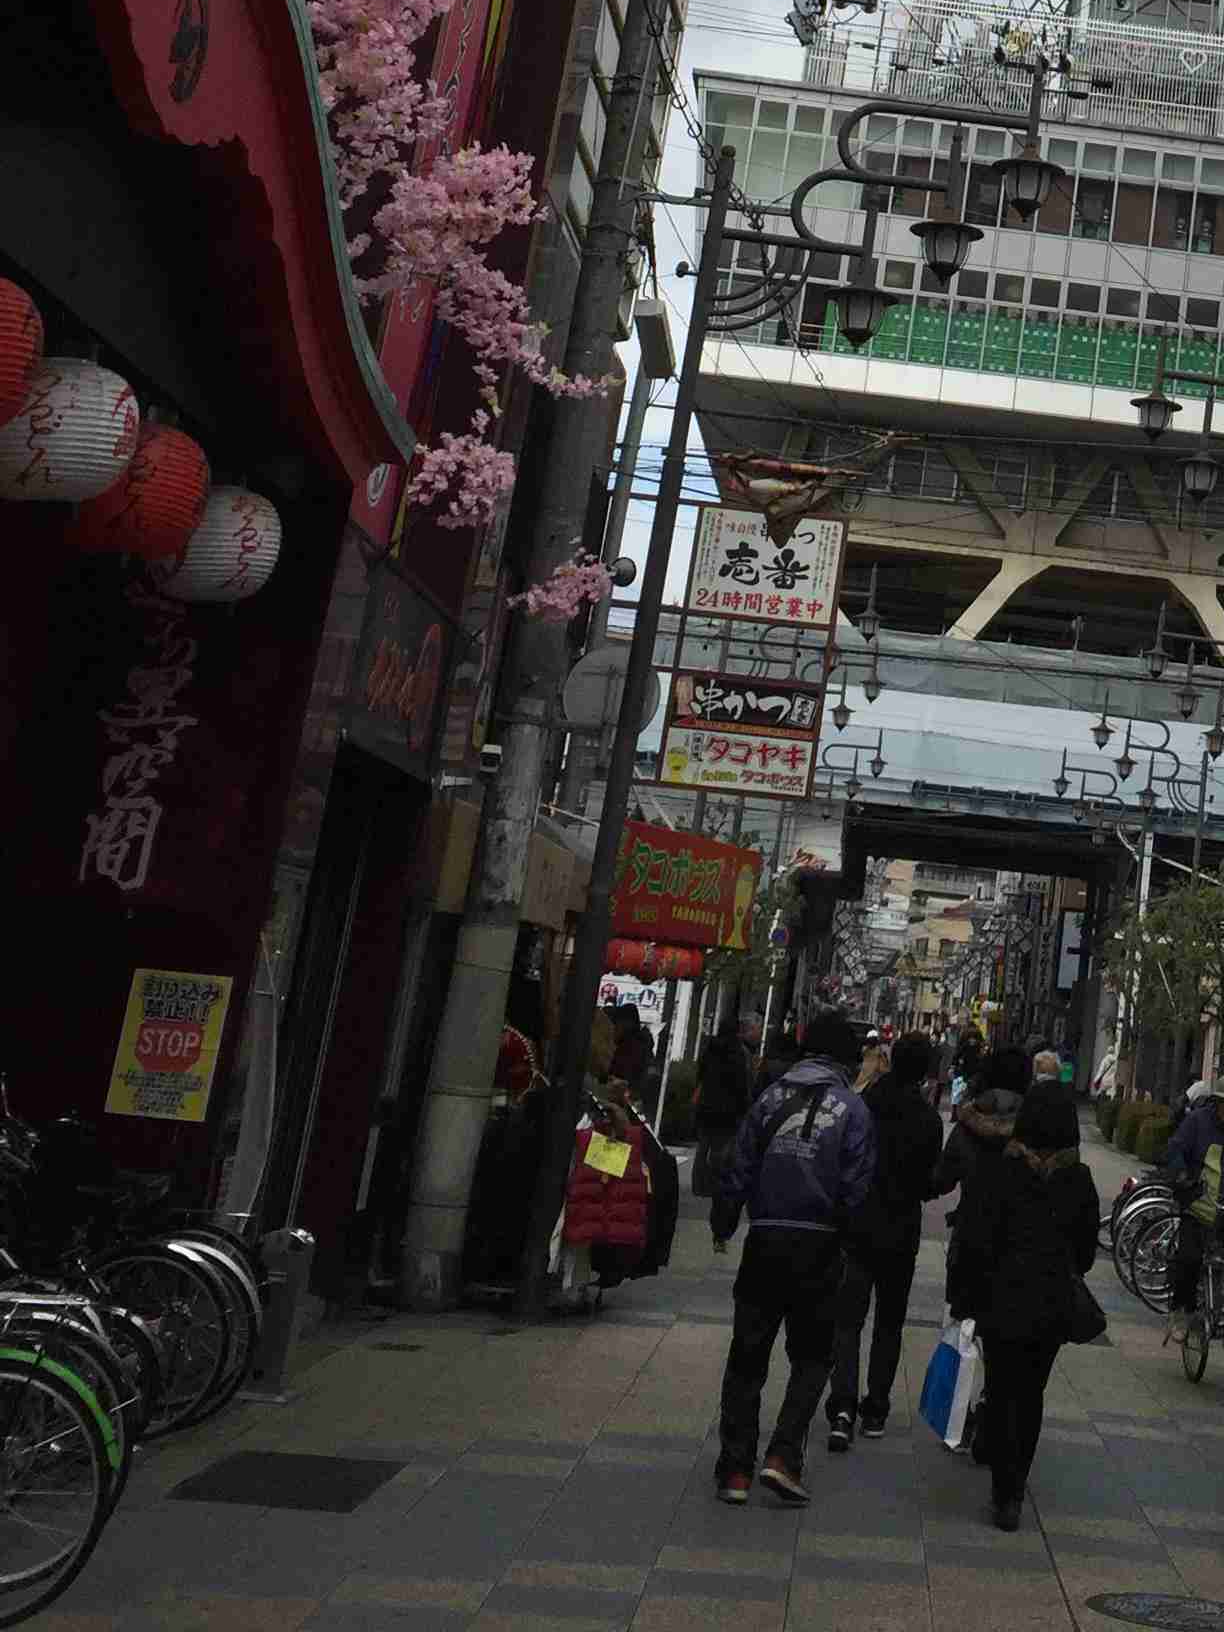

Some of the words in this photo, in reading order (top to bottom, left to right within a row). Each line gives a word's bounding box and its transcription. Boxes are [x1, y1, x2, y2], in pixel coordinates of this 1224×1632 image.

[719, 541, 810, 589] 壱番
[695, 588, 825, 620] 24時間営業中
[690, 679, 792, 724] 串かつ
[707, 735, 806, 770] タコヤキ
[138, 1027, 201, 1057] STOP
